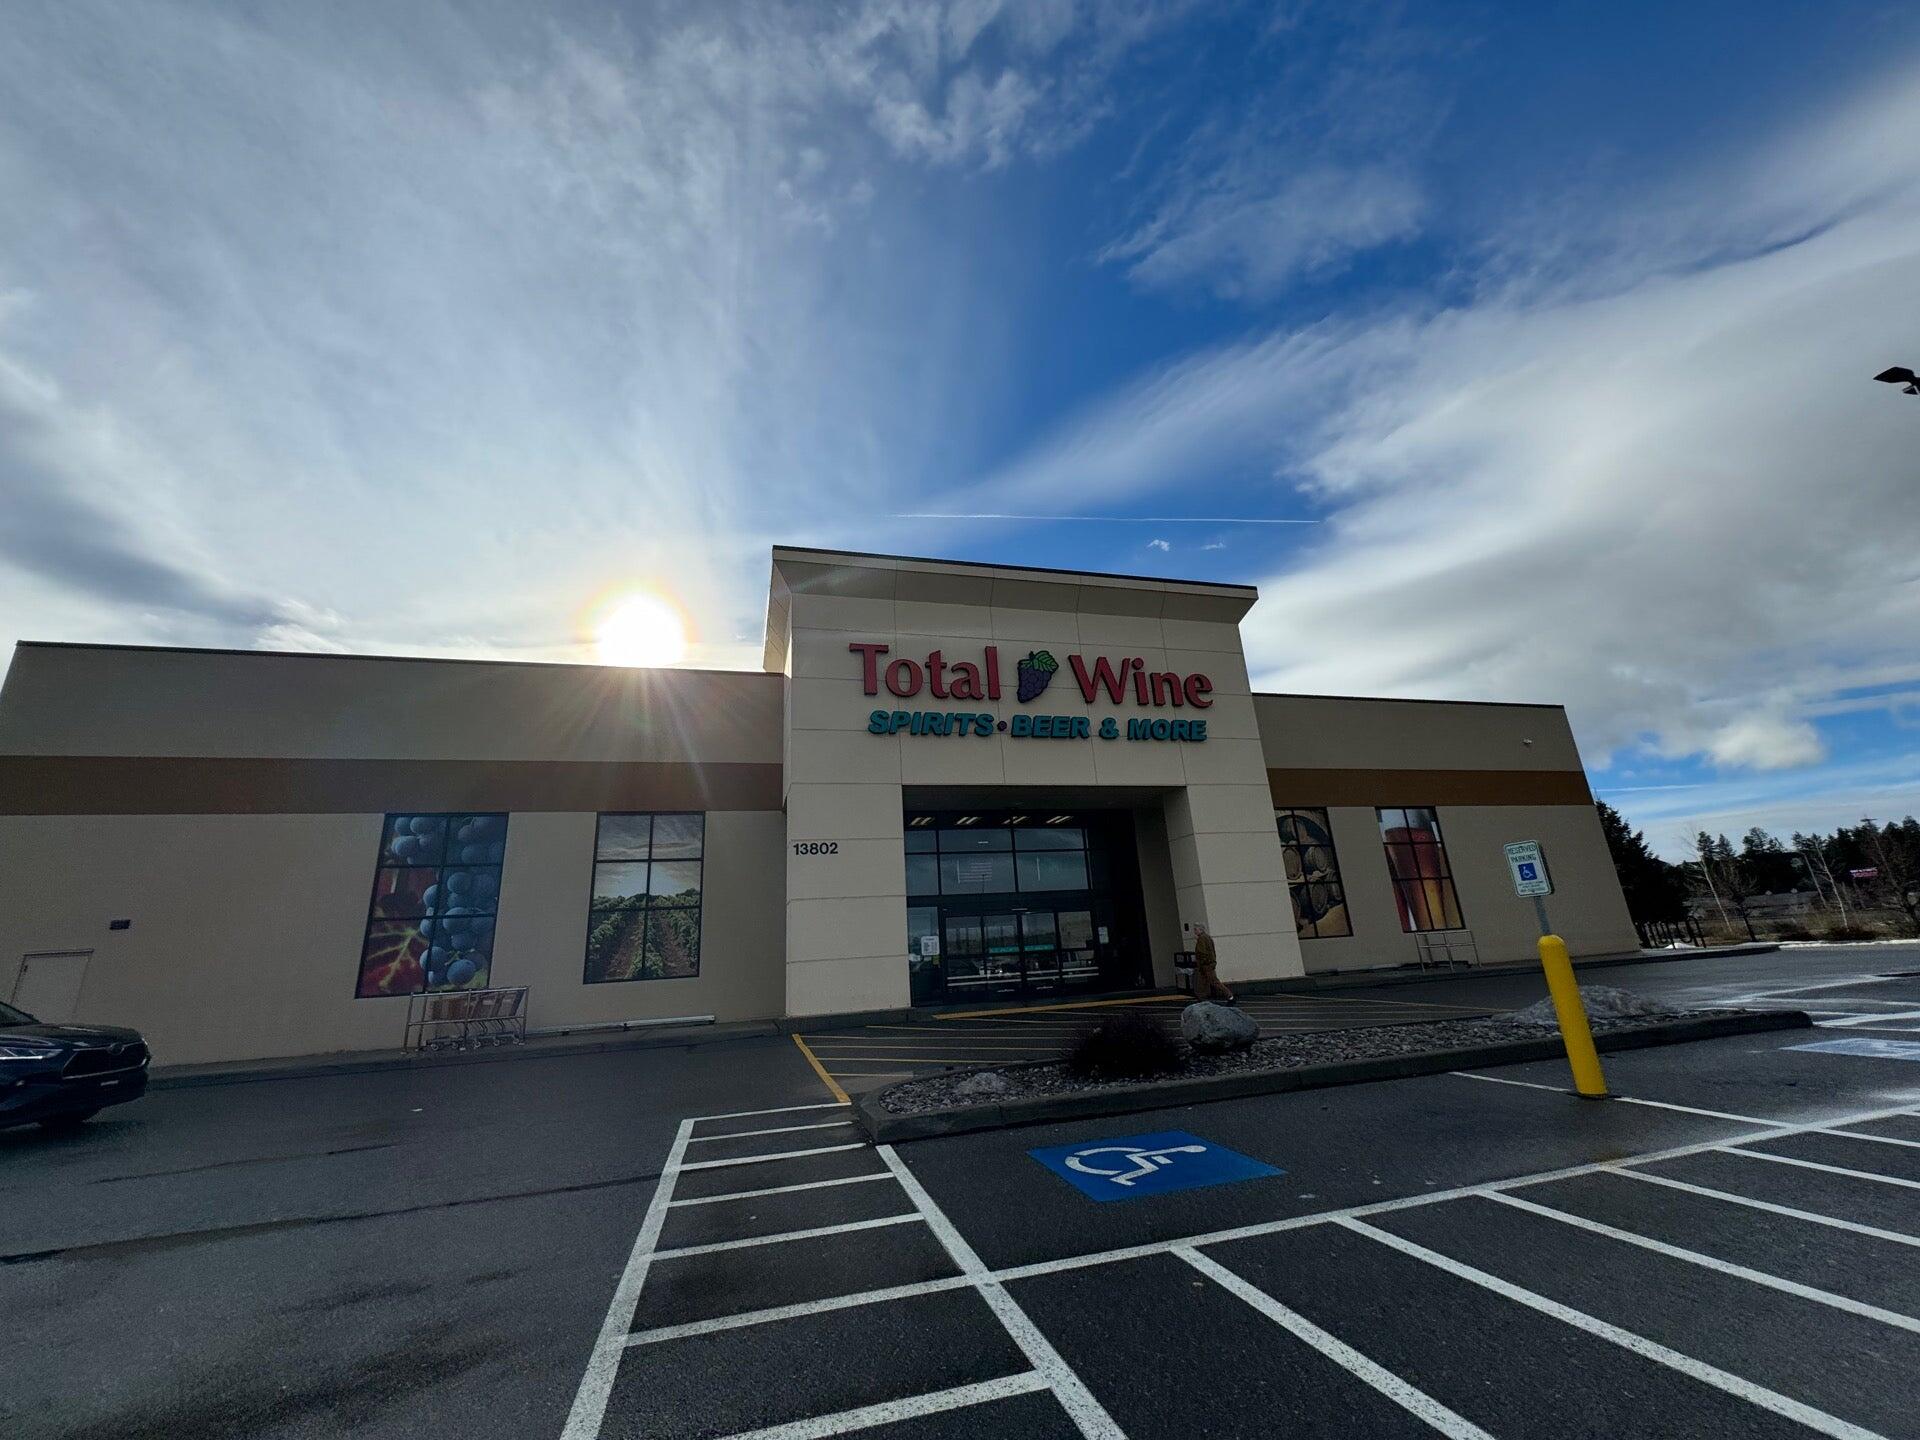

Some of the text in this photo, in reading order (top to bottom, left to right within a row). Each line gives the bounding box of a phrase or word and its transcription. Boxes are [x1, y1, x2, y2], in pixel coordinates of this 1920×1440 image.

[848, 643, 1214, 708] Total Wine
[868, 710, 1208, 742] SPIRITS BEER & MORE
[793, 842, 839, 855] 13802
